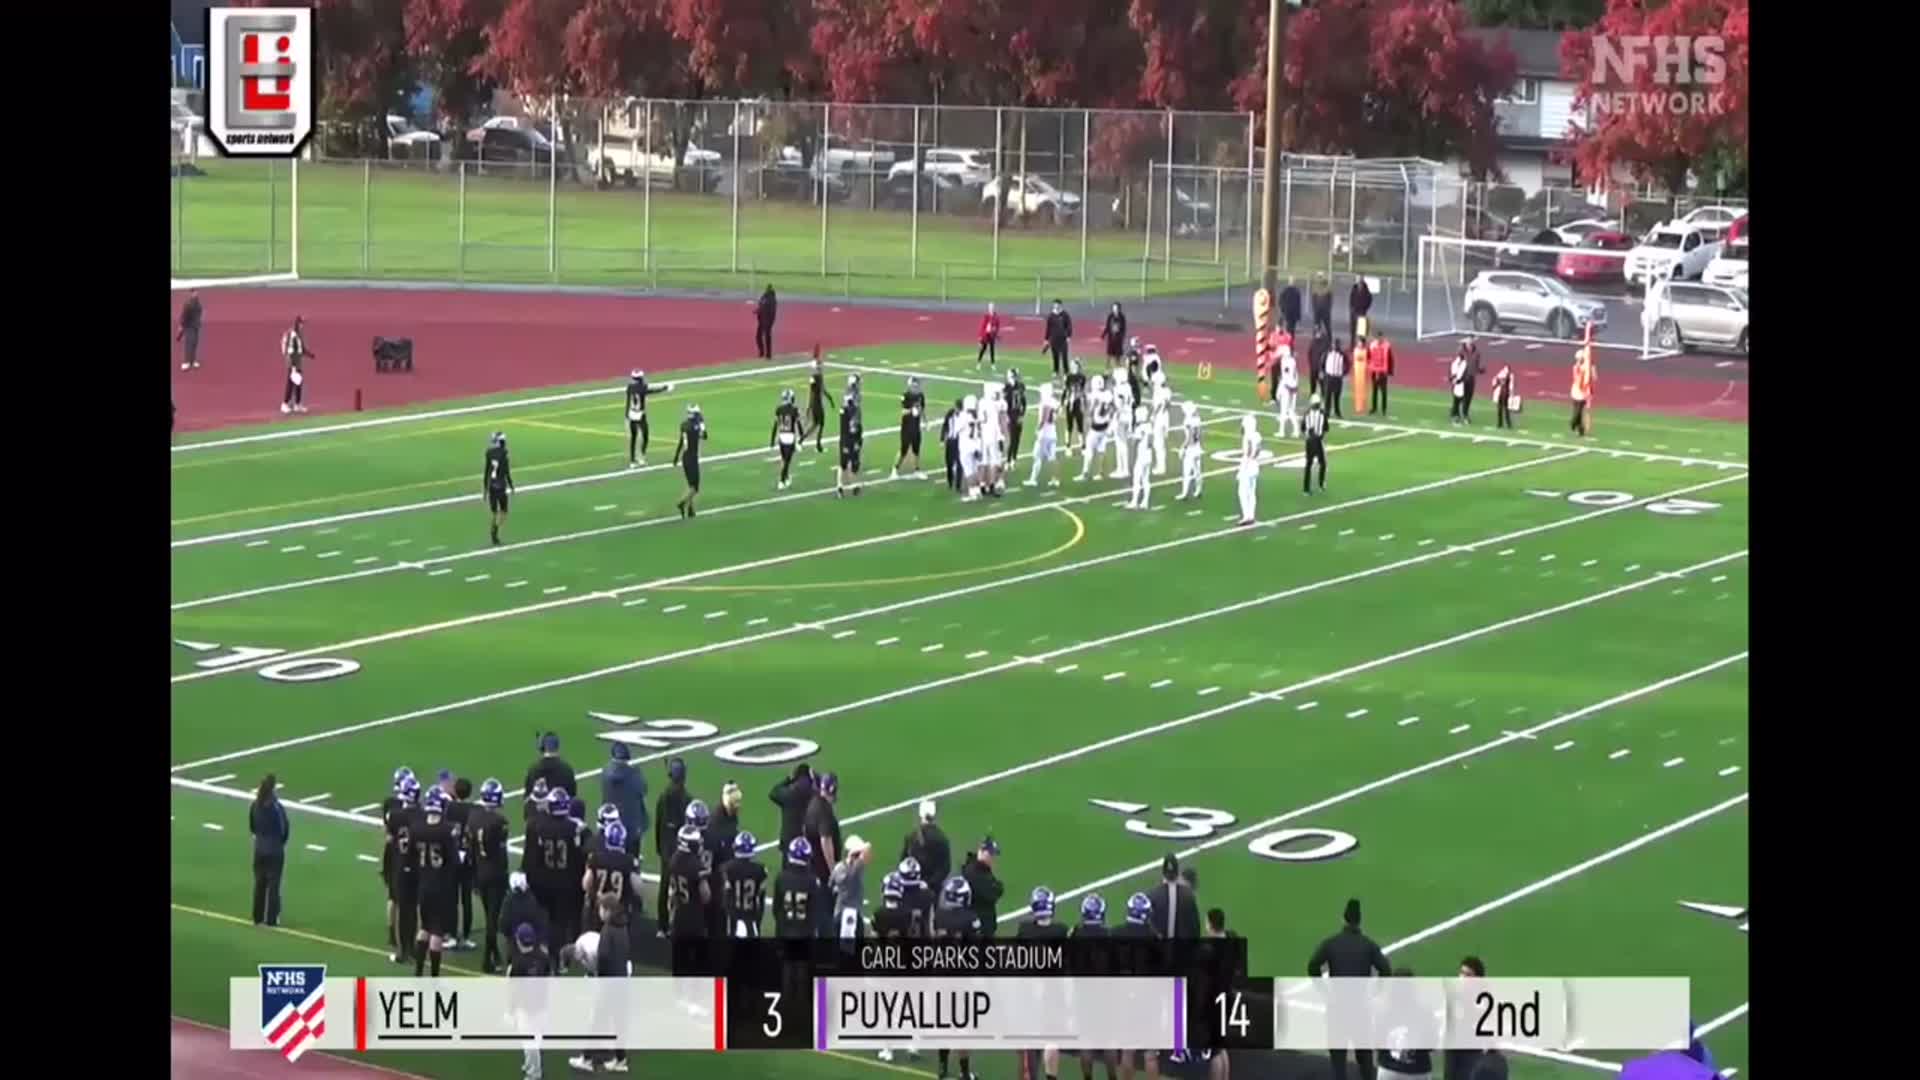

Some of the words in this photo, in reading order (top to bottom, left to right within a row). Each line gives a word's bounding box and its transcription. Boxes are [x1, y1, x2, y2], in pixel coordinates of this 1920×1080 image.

[195, 646, 361, 681] 10
[595, 718, 819, 763] 20
[1124, 806, 1358, 860] 30
